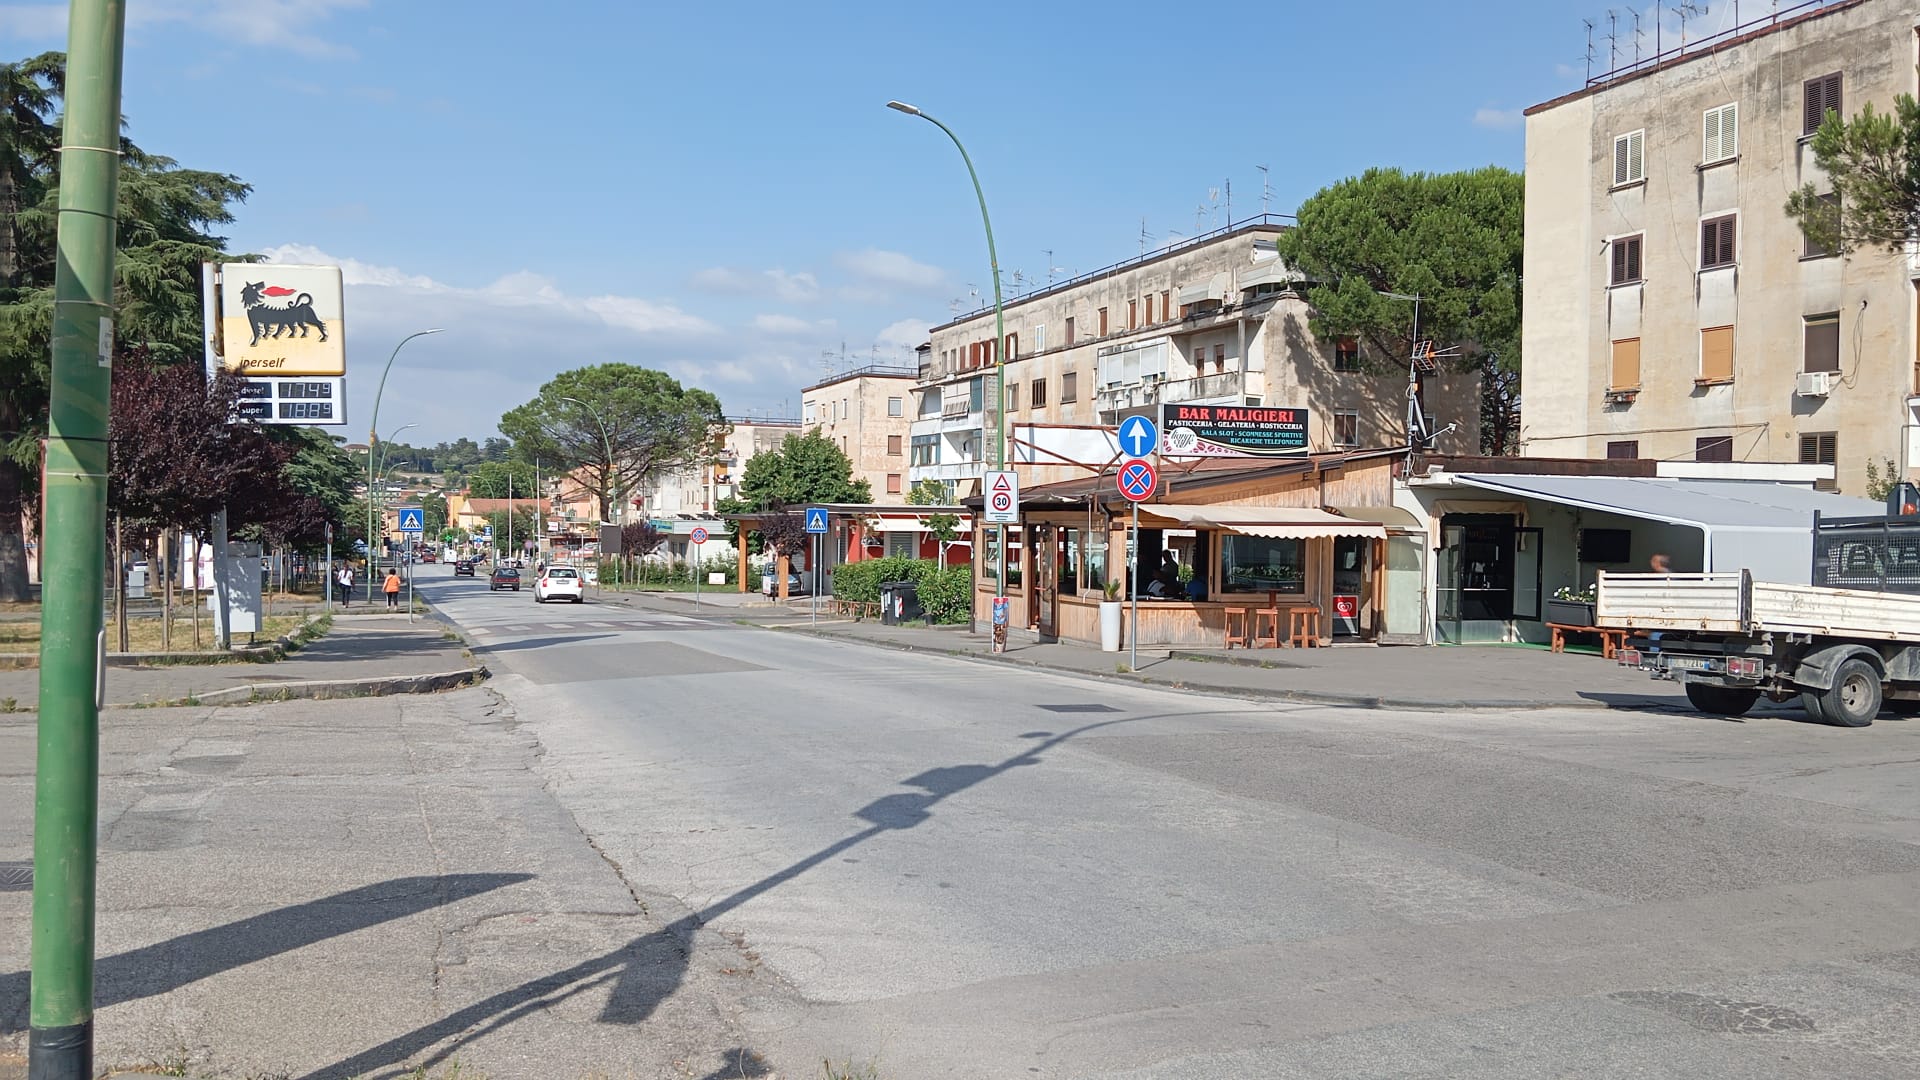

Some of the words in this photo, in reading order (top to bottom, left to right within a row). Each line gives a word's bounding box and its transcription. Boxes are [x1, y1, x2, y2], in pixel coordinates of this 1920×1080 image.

[240, 357, 285, 368] iperself
[241, 407, 264, 415] super
[1179, 407, 1209, 419] BAR
[1216, 408, 1294, 422] MALIGIERI
[1217, 421, 1256, 429] GELATERIA
[1260, 422, 1304, 430] ROSTICCERIA
[1238, 430, 1273, 438] SCOMMESSE
[1230, 437, 1264, 445] RICARICHE
[1264, 438, 1304, 446] TELEFONICHE
[996, 497, 1007, 506] 30
